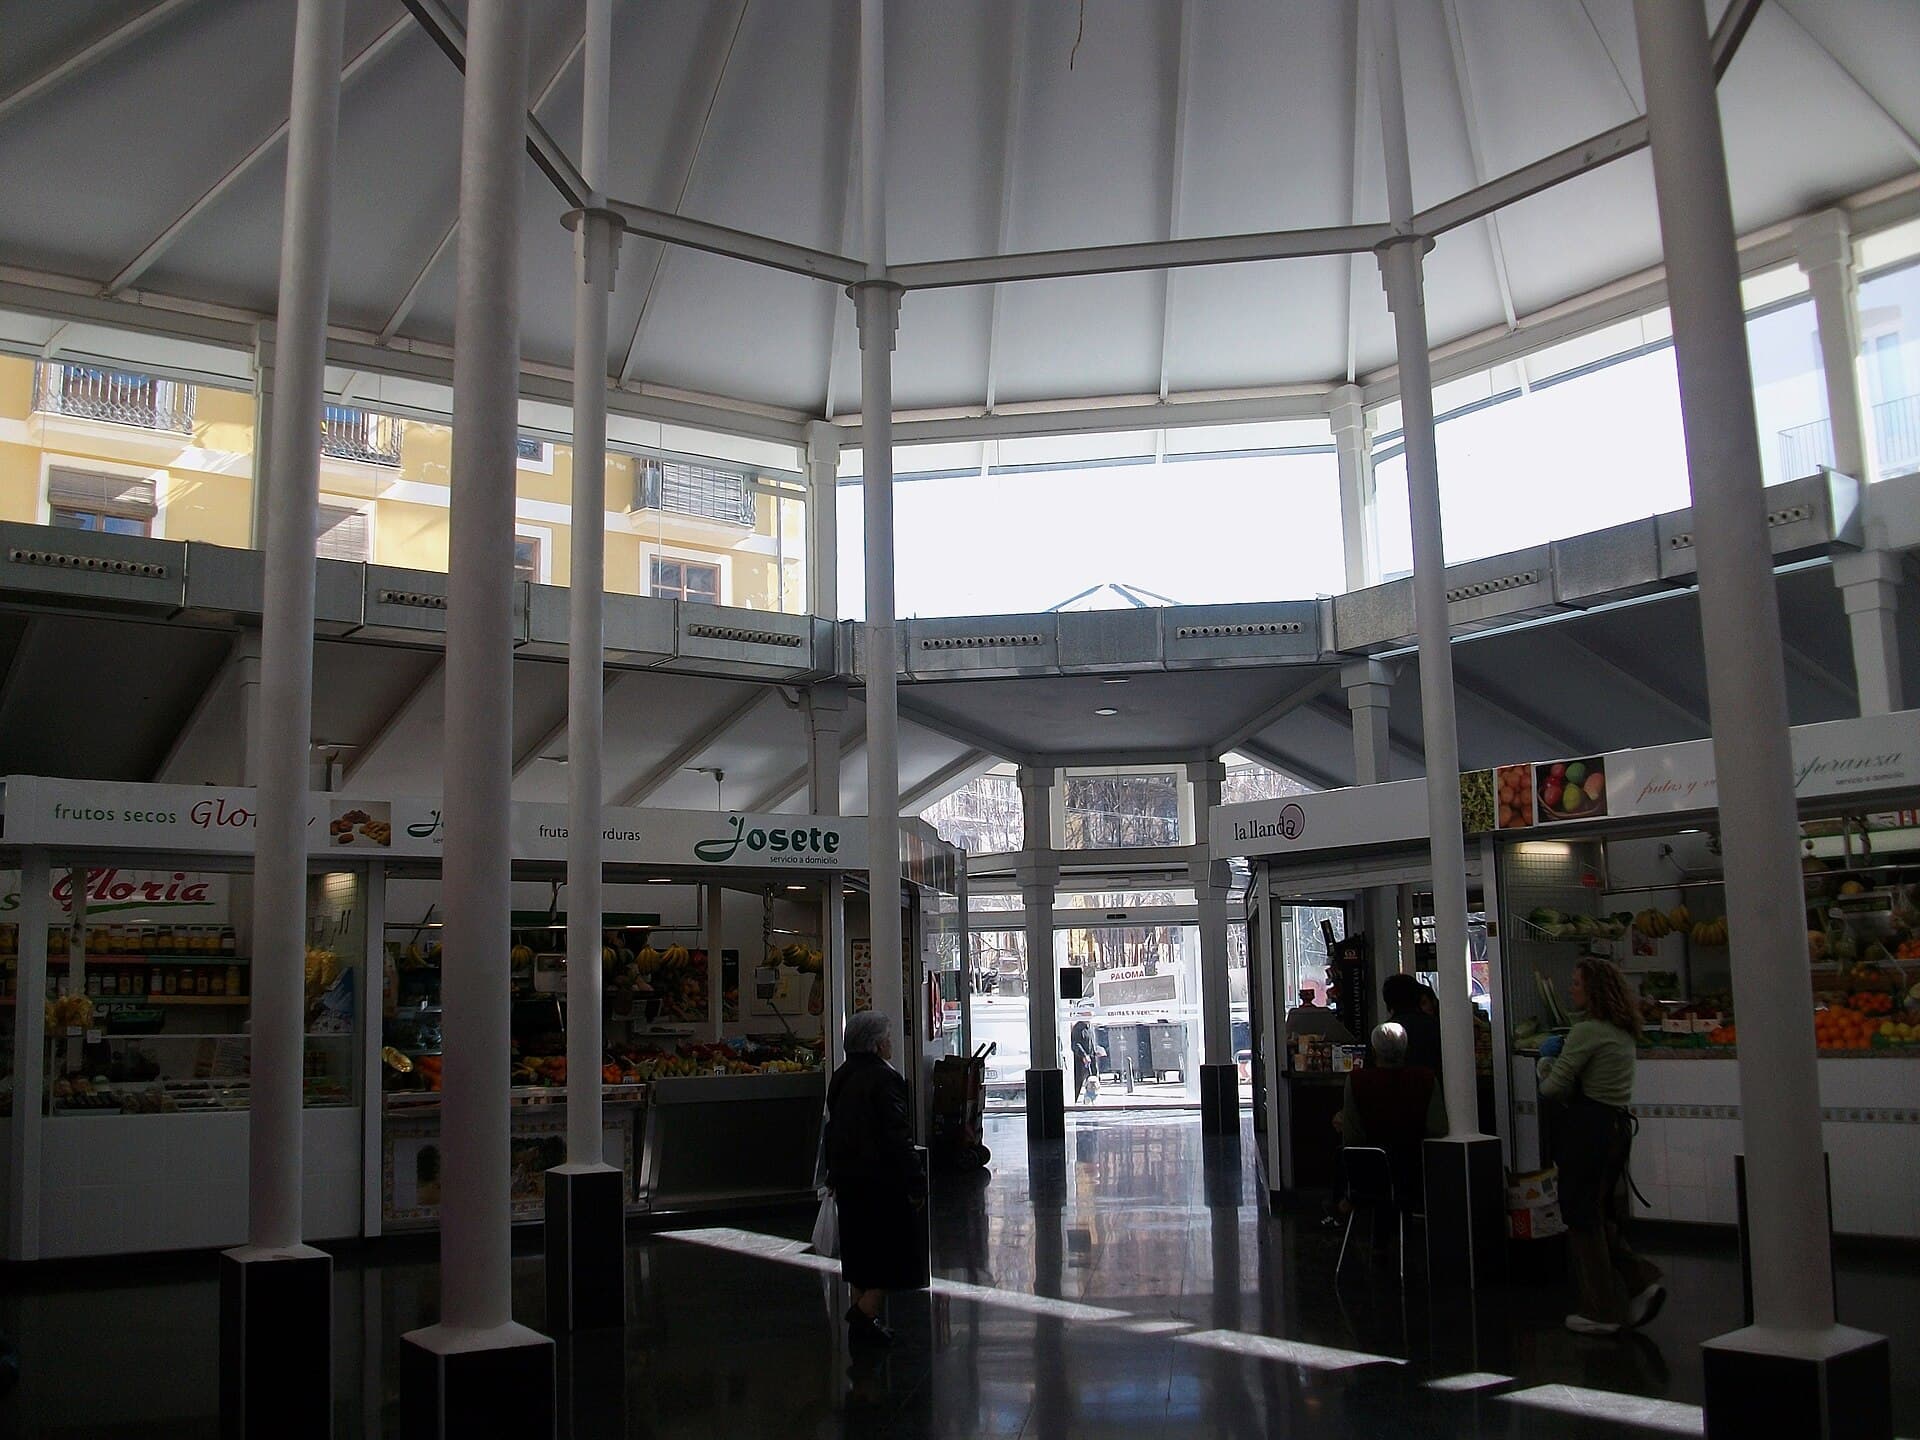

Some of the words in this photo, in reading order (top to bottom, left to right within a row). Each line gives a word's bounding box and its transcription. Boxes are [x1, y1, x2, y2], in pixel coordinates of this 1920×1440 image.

[55, 803, 115, 821] frutos
[124, 808, 177, 824] secos
[539, 824, 569, 839] fruta
[602, 827, 641, 842] rduras
[694, 816, 840, 863] Josete
[769, 855, 798, 864] servicio
[805, 855, 838, 865] domicilio
